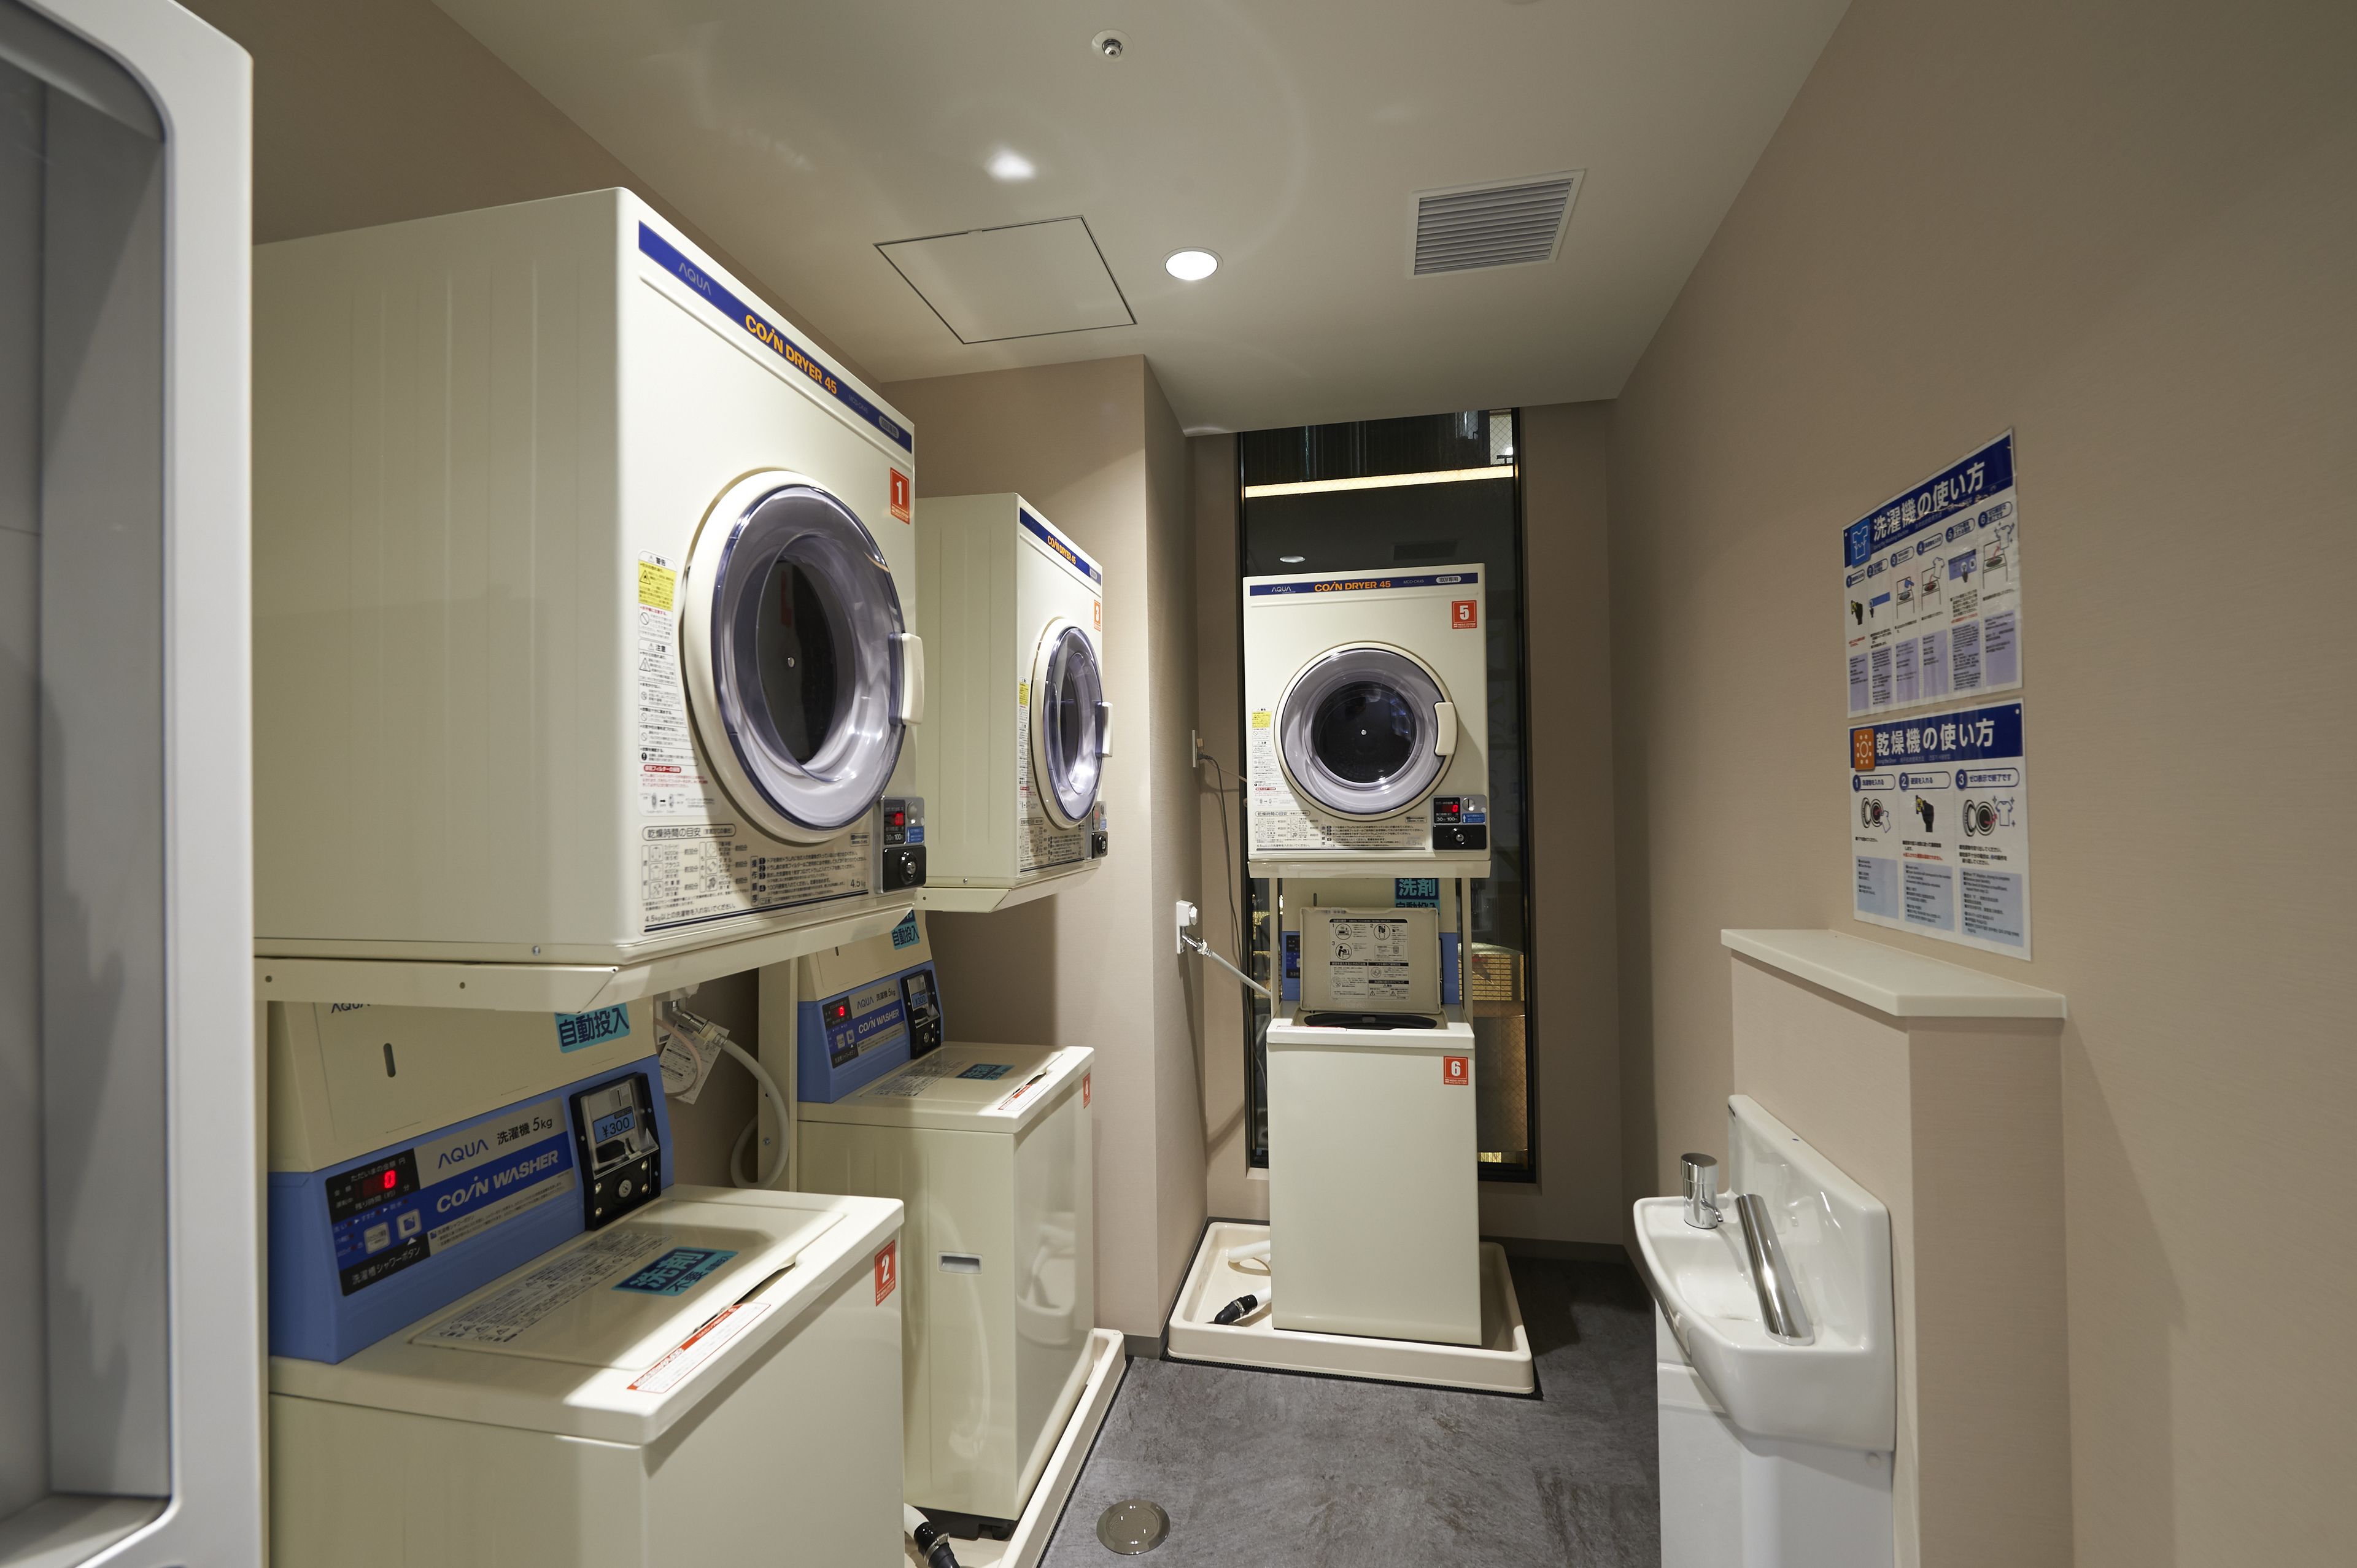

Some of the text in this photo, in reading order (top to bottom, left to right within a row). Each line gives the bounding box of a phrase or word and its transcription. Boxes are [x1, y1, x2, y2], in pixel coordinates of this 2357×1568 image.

[679, 263, 711, 295] AQUA
[786, 344, 822, 384] DRYER
[824, 376, 837, 395] 45
[896, 481, 902, 506] 1
[1873, 461, 1985, 541] 洗濯機の使い方
[1345, 581, 1377, 590] DRYER
[1095, 604, 1099, 622] 3
[1460, 605, 1469, 620] 5
[1876, 718, 1995, 756] 乾燥機の使い方
[1854, 778, 1859, 788] 1
[1902, 776, 1907, 787] 2
[1959, 773, 2011, 786] 3 ゼロ表示で終了です
[647, 827, 701, 839] 乾燥時間の目安
[1399, 878, 1436, 896] 洗剤
[892, 925, 920, 947] 自動投入
[857, 997, 875, 1010] AQUA
[559, 1007, 630, 1047] 自動投入
[877, 1008, 900, 1026] WASHER
[1451, 1060, 1461, 1076] 6
[602, 1117, 630, 1138] ¥300
[438, 1117, 553, 1170] AQUA 洗濯機 5kg
[351, 1156, 406, 1182] ただいまの金額 円
[384, 1169, 397, 1189] 0
[492, 1149, 559, 1189] WASHER
[352, 1246, 420, 1285] 洗濯槽シャワーボタン
[629, 1252, 706, 1288] 洗剤
[881, 1254, 890, 1284] 2
[665, 1272, 708, 1292] 不要
